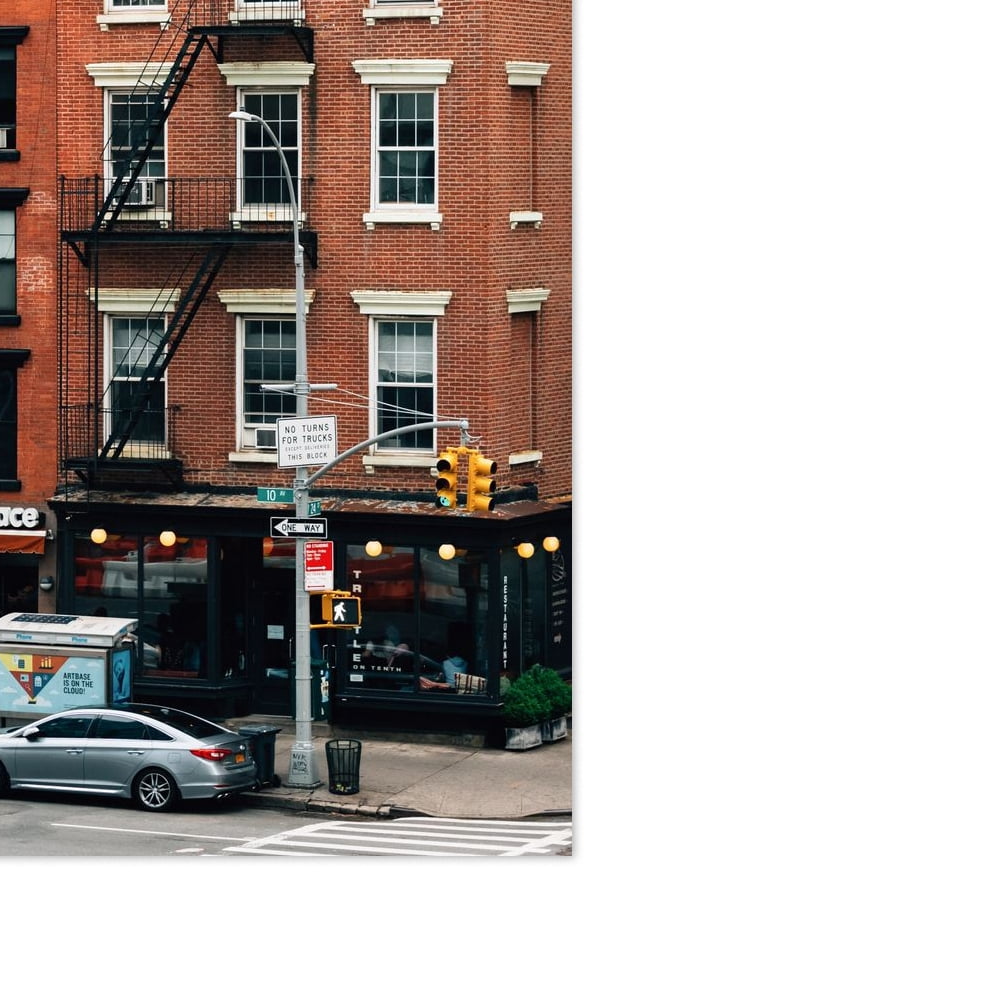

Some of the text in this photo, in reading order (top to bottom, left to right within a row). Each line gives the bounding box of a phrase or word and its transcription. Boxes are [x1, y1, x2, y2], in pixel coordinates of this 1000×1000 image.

[285, 423, 330, 434] NO TURNS
[282, 434, 333, 444] FOR TRUCKS
[288, 451, 328, 461] THIS BLOCK
[266, 489, 277, 501] 10
[310, 503, 317, 514] 24
[281, 523, 321, 532] ONE WAY
[352, 570, 362, 662] TRTLE
[63, 672, 91, 681] ARTBASE
[71, 680, 80, 688] ON
[82, 680, 94, 688] THE
[63, 687, 86, 695] CLOUD!
